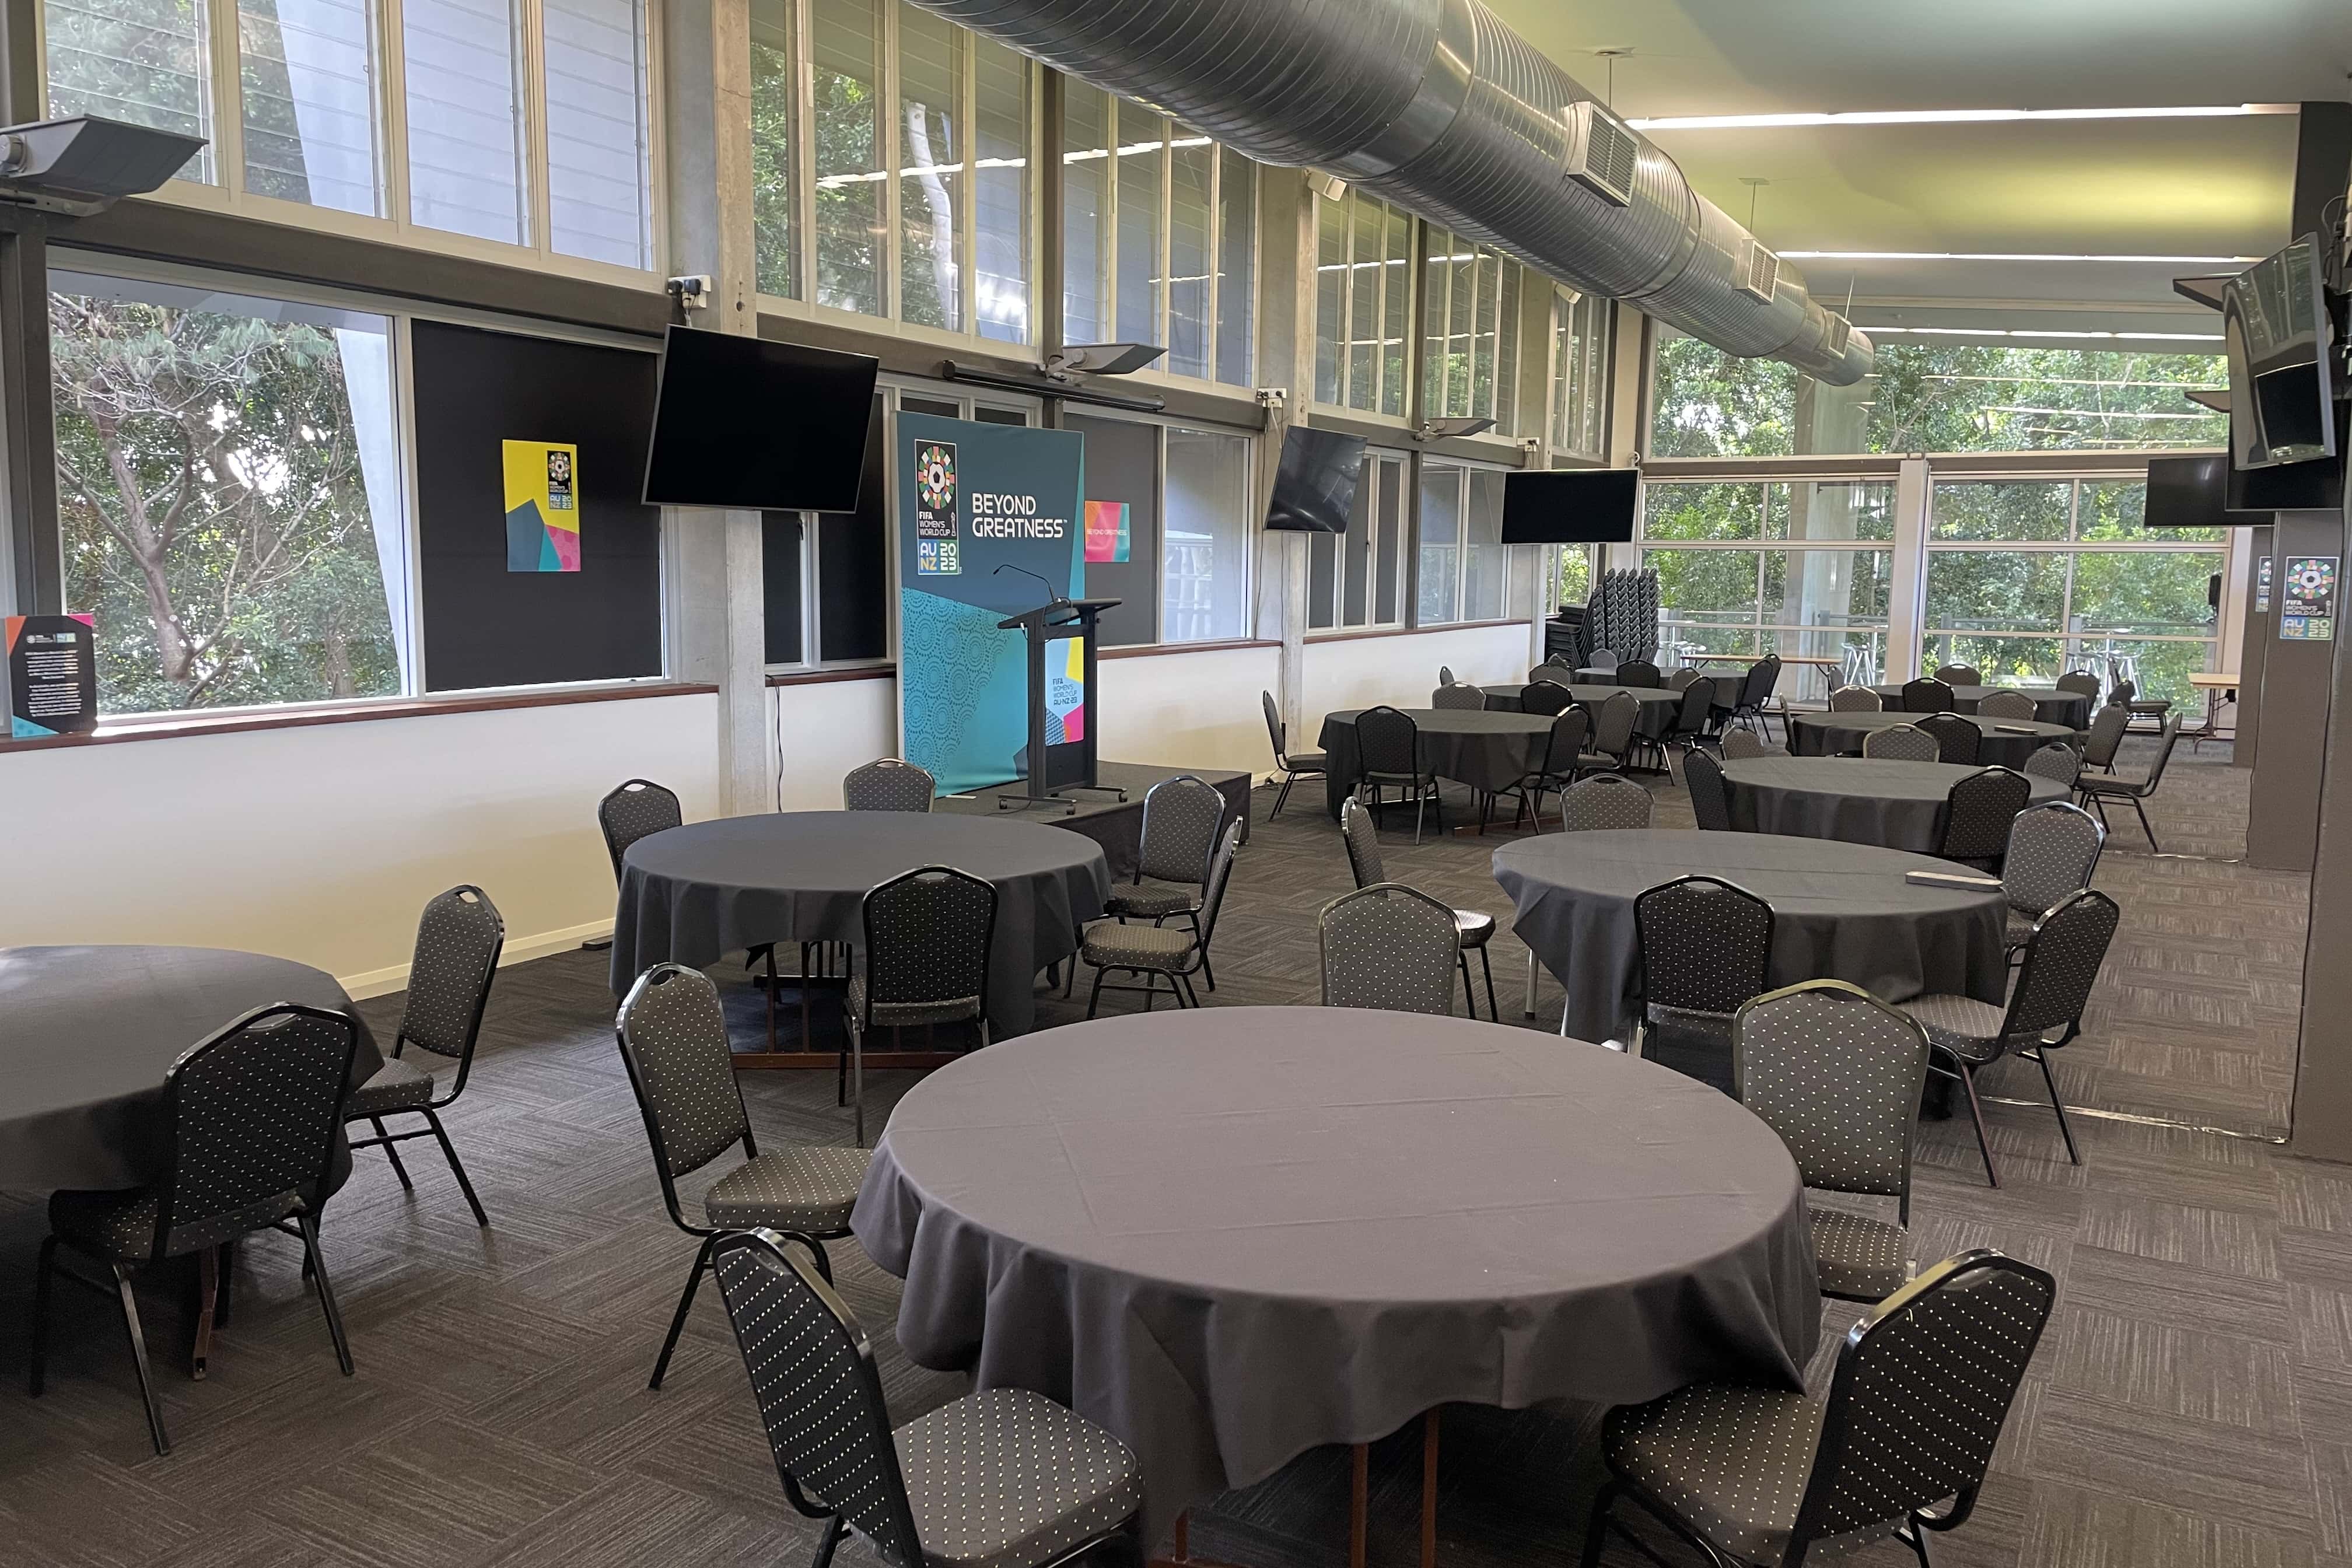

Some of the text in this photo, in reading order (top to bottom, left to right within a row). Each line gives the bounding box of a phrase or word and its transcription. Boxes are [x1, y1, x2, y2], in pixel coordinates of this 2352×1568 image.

[972, 493, 1037, 515] BEYOND
[919, 511, 933, 520] FIFA
[919, 520, 946, 528] WOMEN'S
[972, 517, 1063, 538] GREATNESS
[919, 528, 939, 536] WORLD
[920, 542, 957, 556] AU 20
[920, 557, 937, 570] NZ
[940, 556, 957, 570] 23
[2284, 619, 2330, 628] AU 20
[2283, 628, 2329, 637] NZ 23
